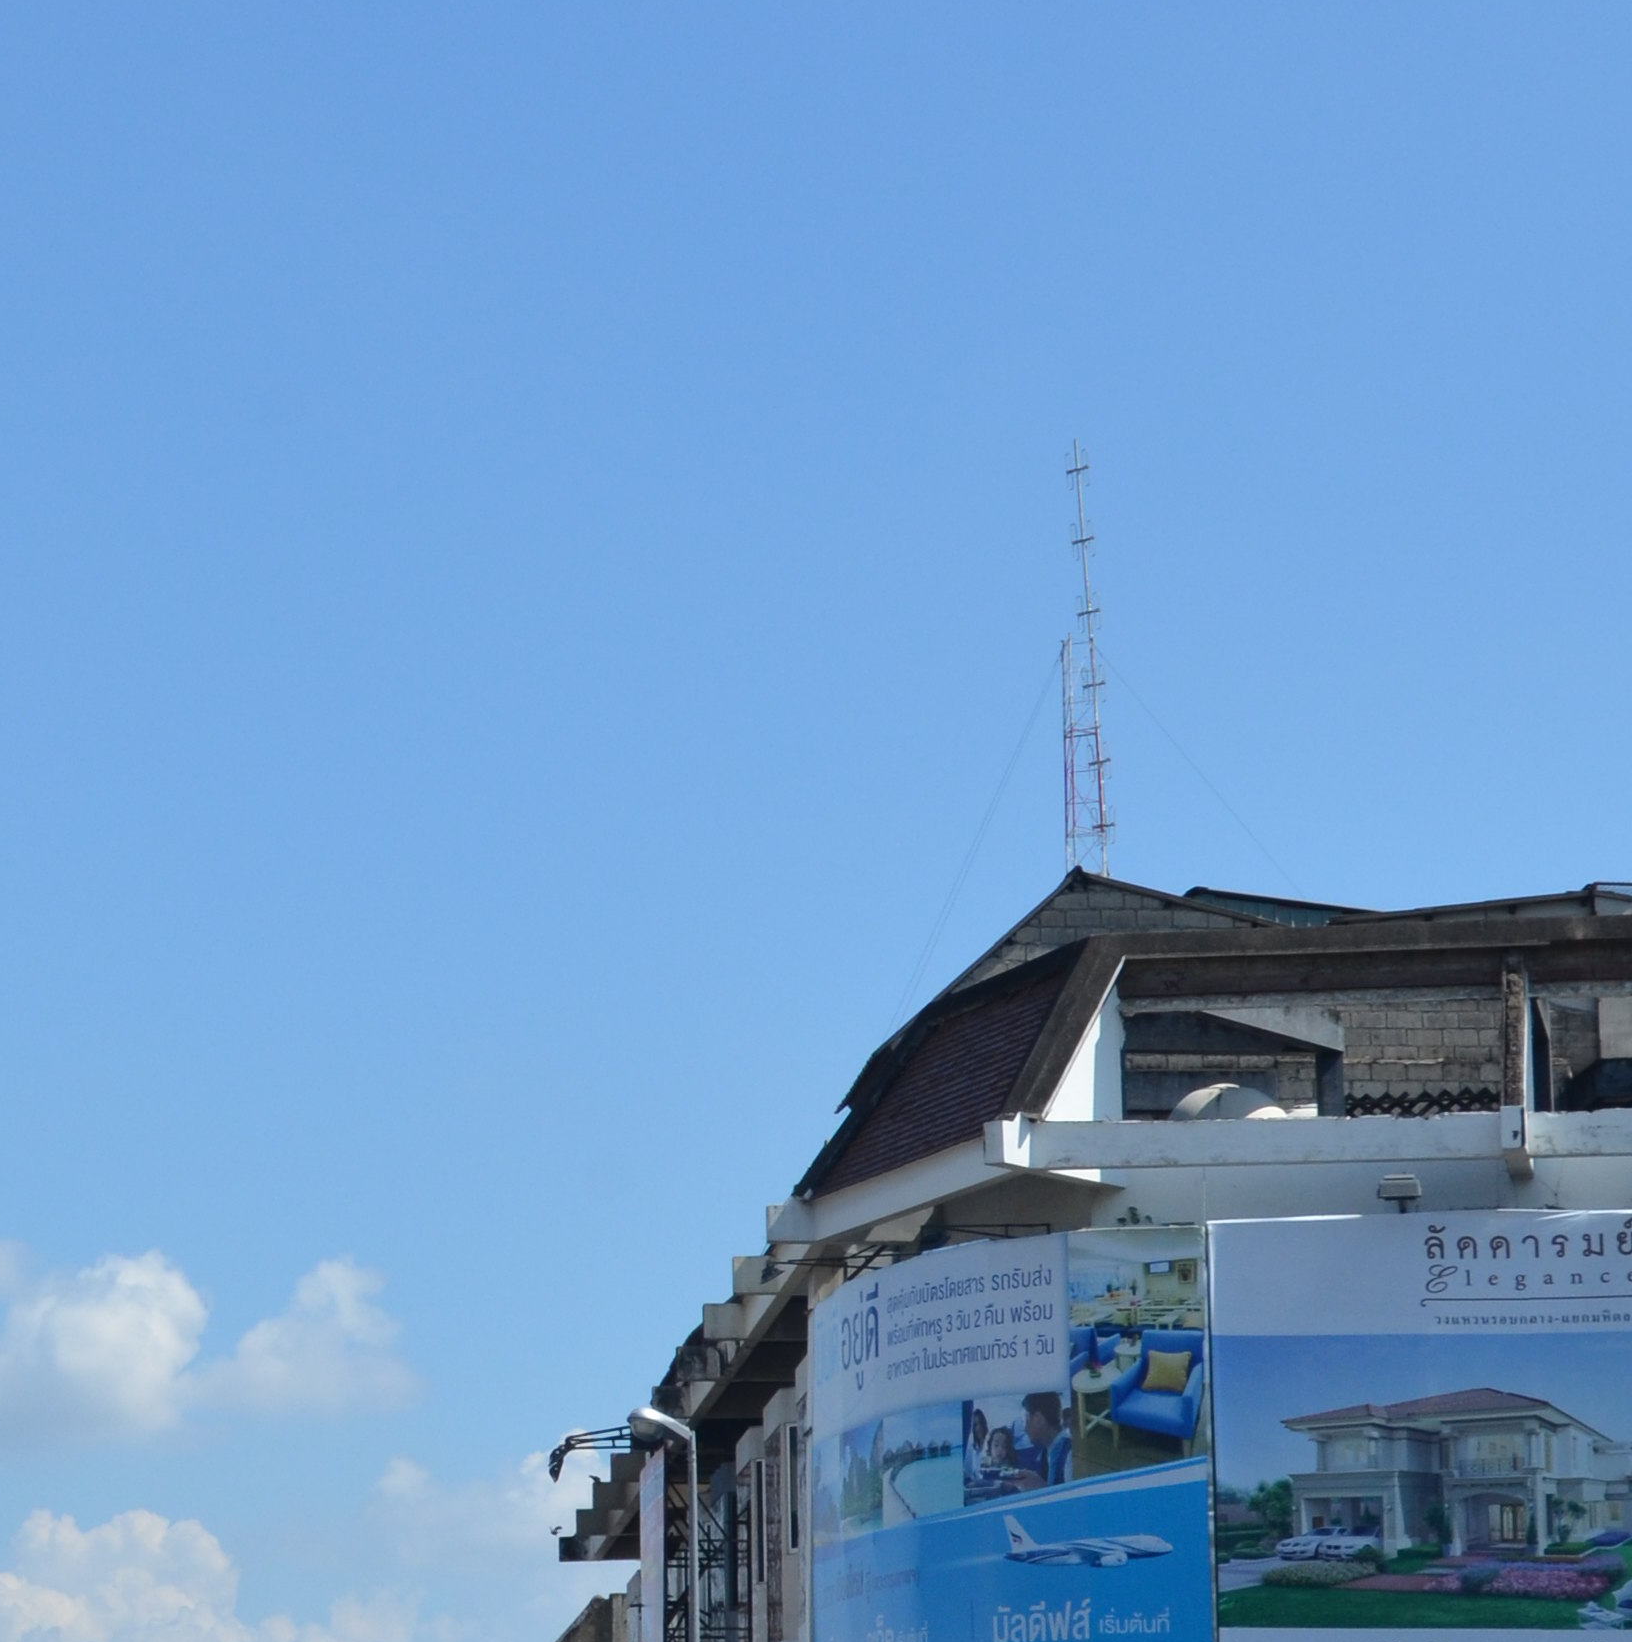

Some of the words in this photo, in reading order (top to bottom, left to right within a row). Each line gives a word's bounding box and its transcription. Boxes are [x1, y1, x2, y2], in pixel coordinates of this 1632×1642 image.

[991, 1264, 1052, 1291] รถรับส่ง
[945, 1314, 953, 1333] 3
[956, 1310, 970, 1331] วัน
[974, 1312, 981, 1327] 2
[984, 1303, 1005, 1326] คืน
[1010, 1303, 1054, 1324] พร้อม
[841, 1282, 879, 1391] อยู่ดี
[1023, 1340, 1029, 1356] 1
[1036, 1334, 1055, 1355] วัน
[1099, 1607, 1171, 1634] เริ่มต้นที่
